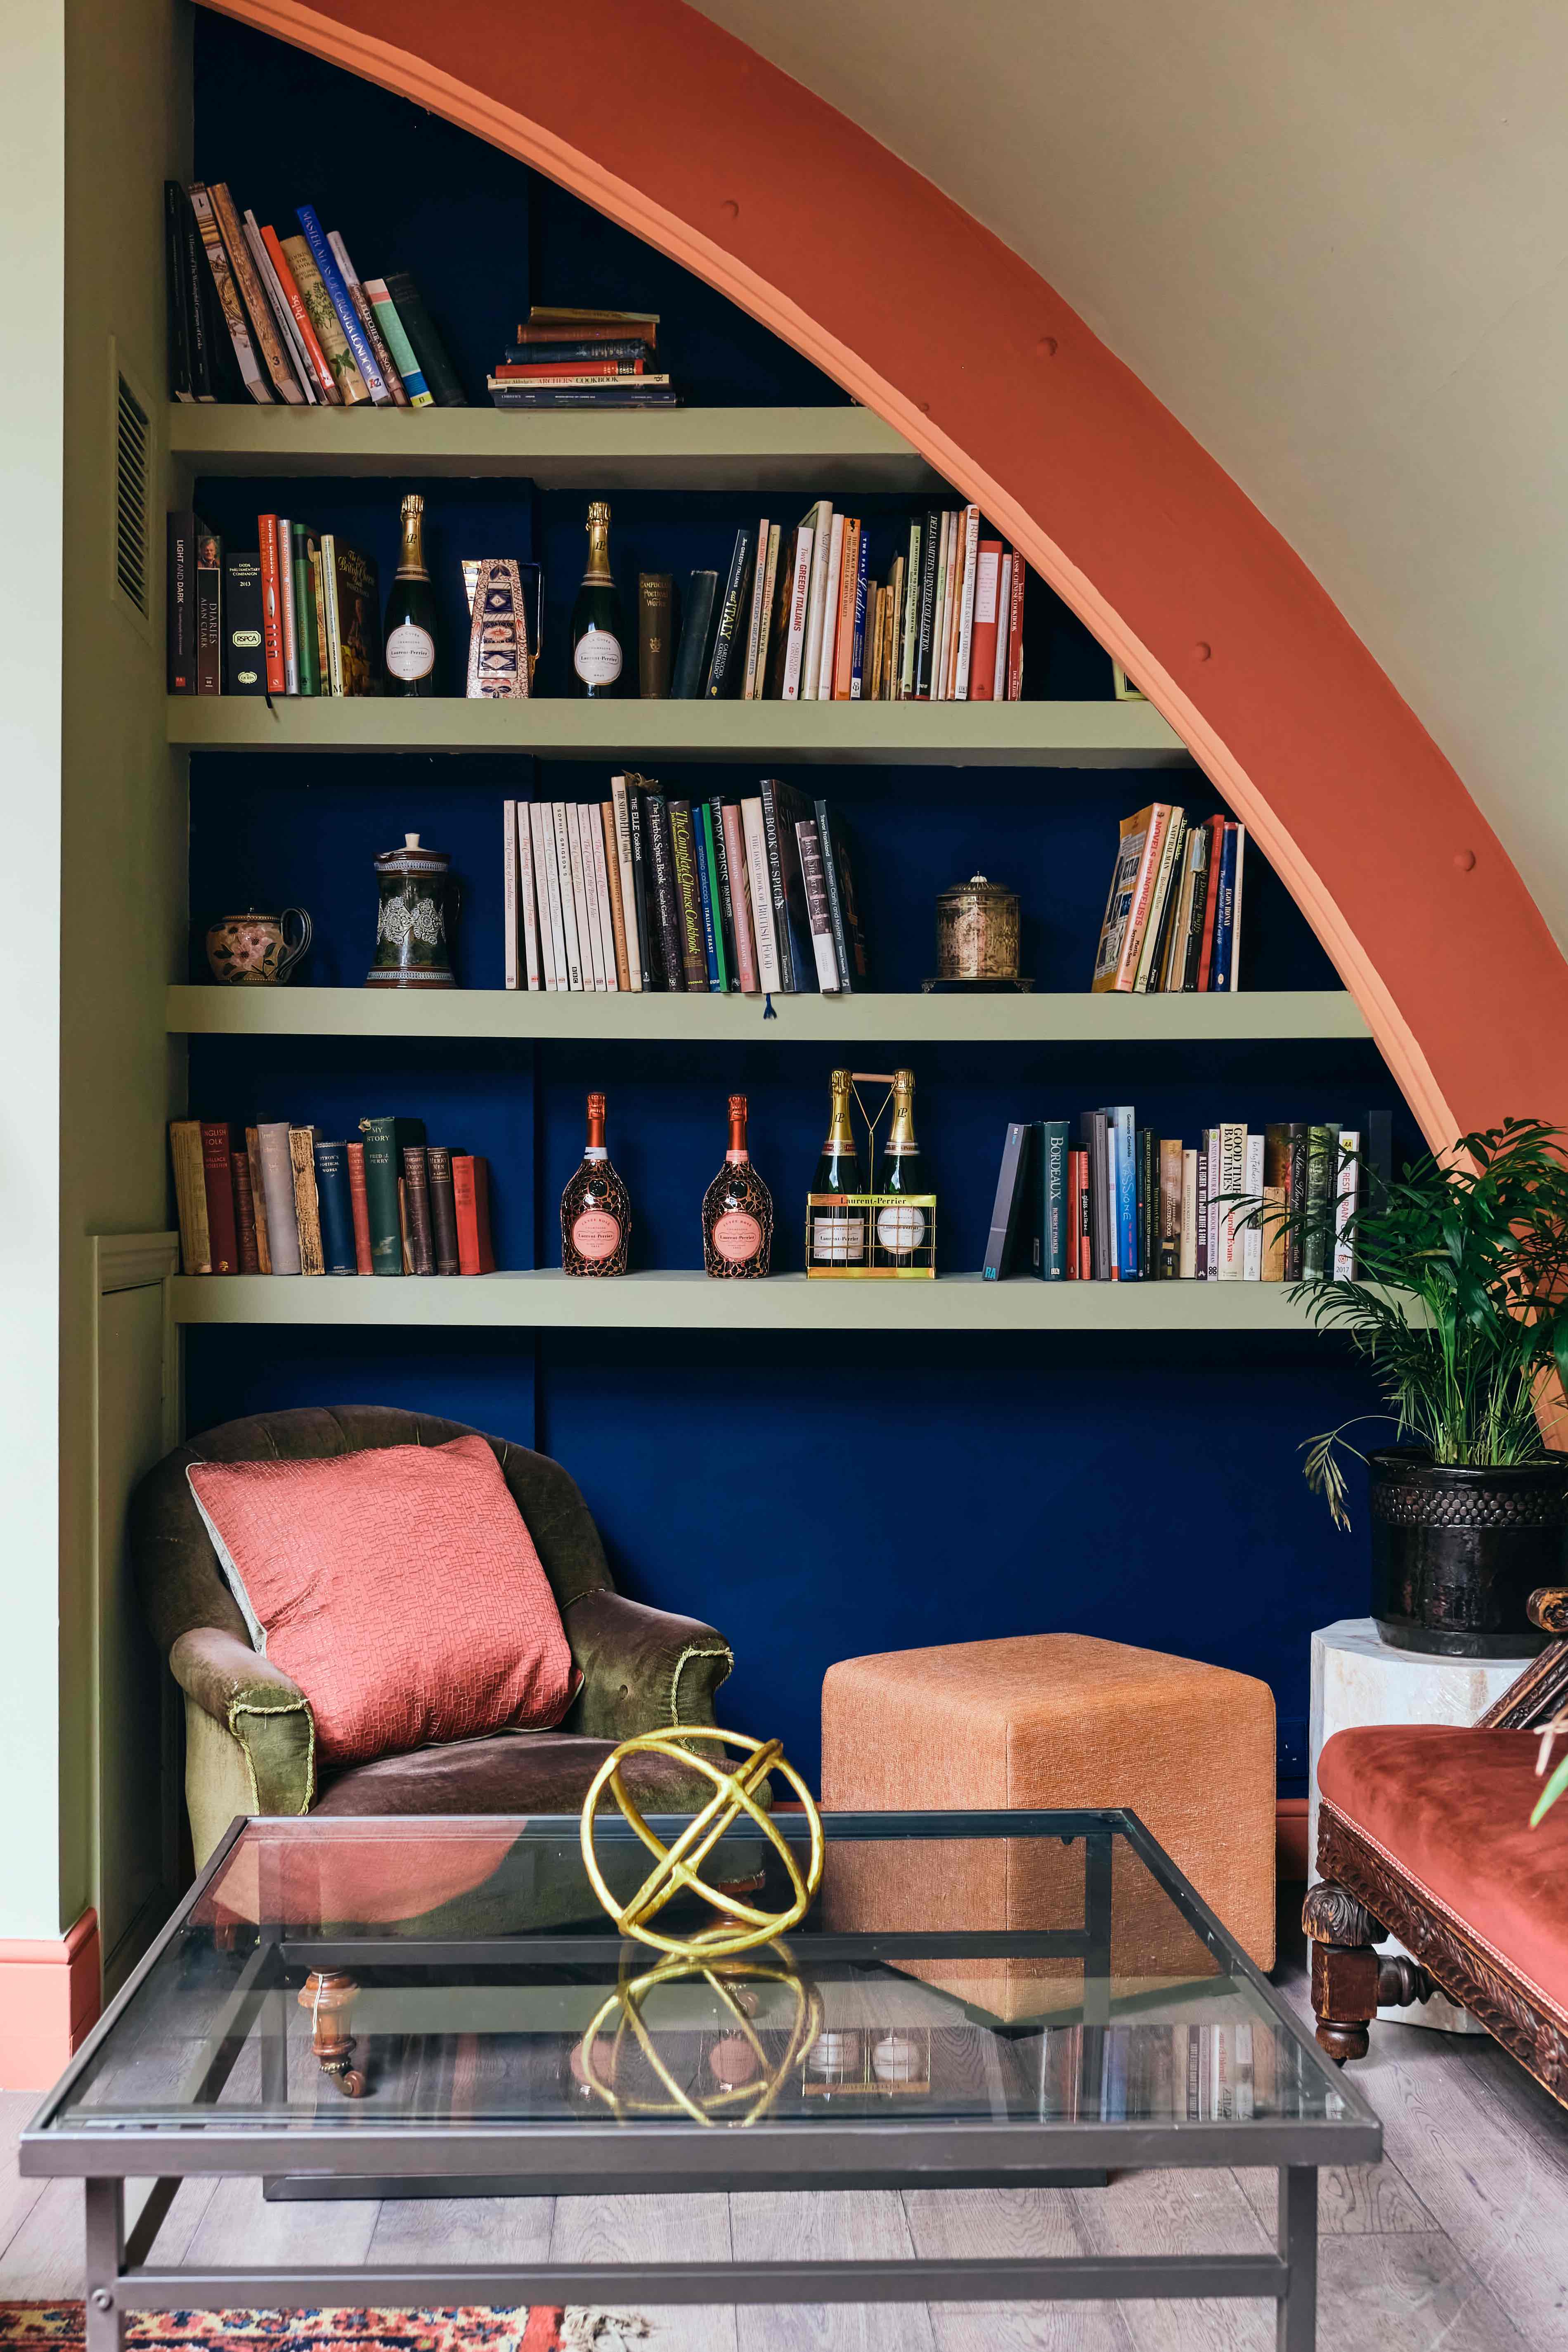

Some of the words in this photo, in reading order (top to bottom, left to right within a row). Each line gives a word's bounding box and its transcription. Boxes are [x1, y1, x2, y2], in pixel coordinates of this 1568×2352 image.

[292, 294, 305, 320] Pubs
[301, 211, 323, 247] MASTER
[350, 333, 374, 377] LONDON
[576, 375, 619, 383] COOKBOOK
[928, 515, 938, 539] DELIA
[799, 547, 808, 562] Two
[926, 539, 936, 570] SMITH'S
[795, 564, 808, 595] GREEDY
[924, 572, 934, 602] WINTER
[854, 577, 868, 624] Ladies
[208, 603, 218, 644] DIARIES
[720, 601, 738, 638] ITALY
[792, 596, 805, 632] ITALIANS
[921, 604, 931, 651] COLLECTION
[713, 643, 724, 675] CONTALDO
[717, 643, 729, 676] CARLUCCIO
[617, 801, 627, 821] SECOND
[762, 789, 773, 814] THE
[620, 822, 629, 839] ELLE
[651, 814, 660, 834] Herb
[675, 810, 688, 830] The
[765, 817, 777, 848] BOOK
[653, 833, 661, 843] &
[1149, 821, 1162, 857] NOVELS
[1166, 824, 1177, 856] NATURAL
[1177, 827, 1186, 844] Queen
[594, 851, 604, 873] Cooking
[653, 842, 663, 863] Spice
[675, 829, 692, 874] Complete
[716, 843, 728, 882] CRISIS
[731, 847, 736, 856] OF
[753, 851, 762, 871] DAIRY
[769, 852, 778, 867] OF
[1163, 855, 1171, 870] MAN
[656, 864, 665, 884] Book
[808, 864, 816, 887] HEART
[1146, 859, 1154, 874] and
[681, 873, 695, 909] Chinese
[821, 831, 830, 857] Frankland
[826, 861, 834, 887] Between
[833, 919, 842, 941] Mystery
[1157, 875, 1166, 894] Robert
[1195, 880, 1207, 910] Darling
[757, 893, 764, 903] OF
[1134, 876, 1152, 926] NOVELISTS
[1154, 894, 1162, 909] Allen
[660, 905, 668, 927] Garland
[757, 904, 769, 940] BRITISH
[1193, 913, 1204, 935] Buffy
[686, 909, 699, 954] Cookbook
[762, 944, 772, 970] FOOD
[1125, 928, 1138, 968] Seymour-Smith
[1132, 939, 1140, 957] Martin
[1224, 1128, 1233, 1151] BAD
[1232, 1127, 1242, 1162] GOOD
[1050, 1136, 1064, 1200] BORDEAUX
[1223, 1154, 1232, 1190] TIMES
[1227, 1208, 1235, 1235] Harold
[1226, 1238, 1235, 1262] Evans
[985, 1266, 996, 1280] RA
